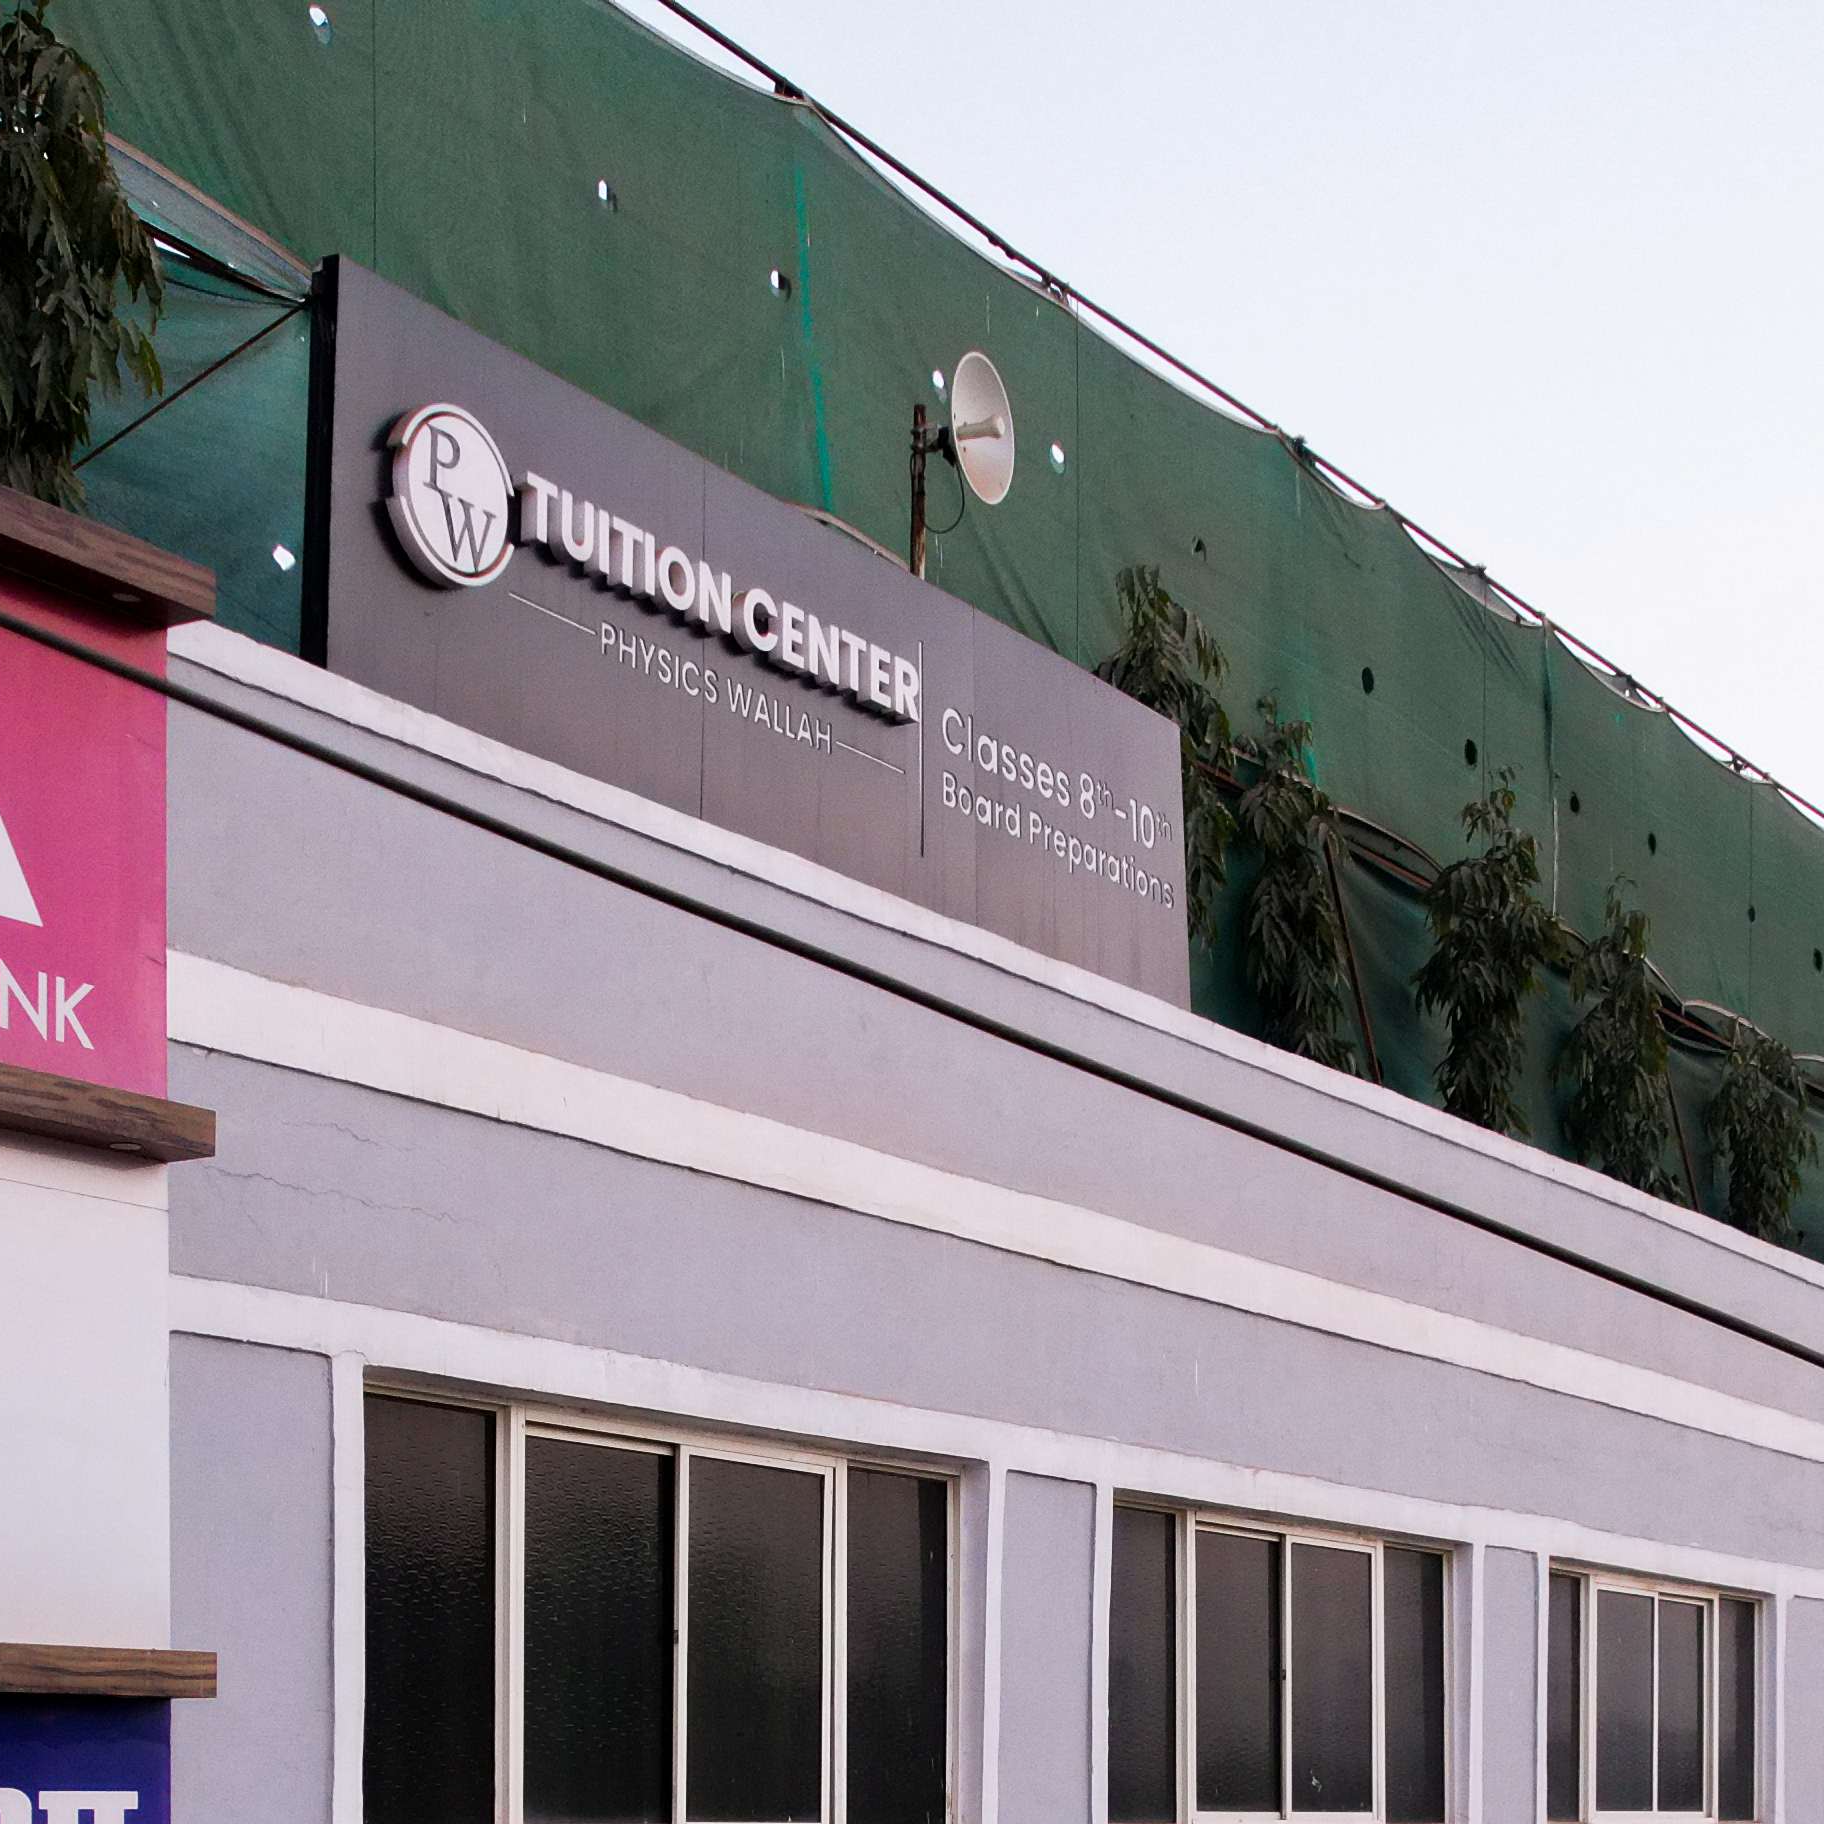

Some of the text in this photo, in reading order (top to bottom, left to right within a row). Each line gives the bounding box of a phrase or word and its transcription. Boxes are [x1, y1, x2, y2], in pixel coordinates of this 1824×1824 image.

[520, 470, 920, 724] TUITION CENTER
[600, 621, 833, 755] PHYSICS WALLAH
[940, 707, 1072, 811] Classes
[942, 771, 1176, 911] Board Preparations
